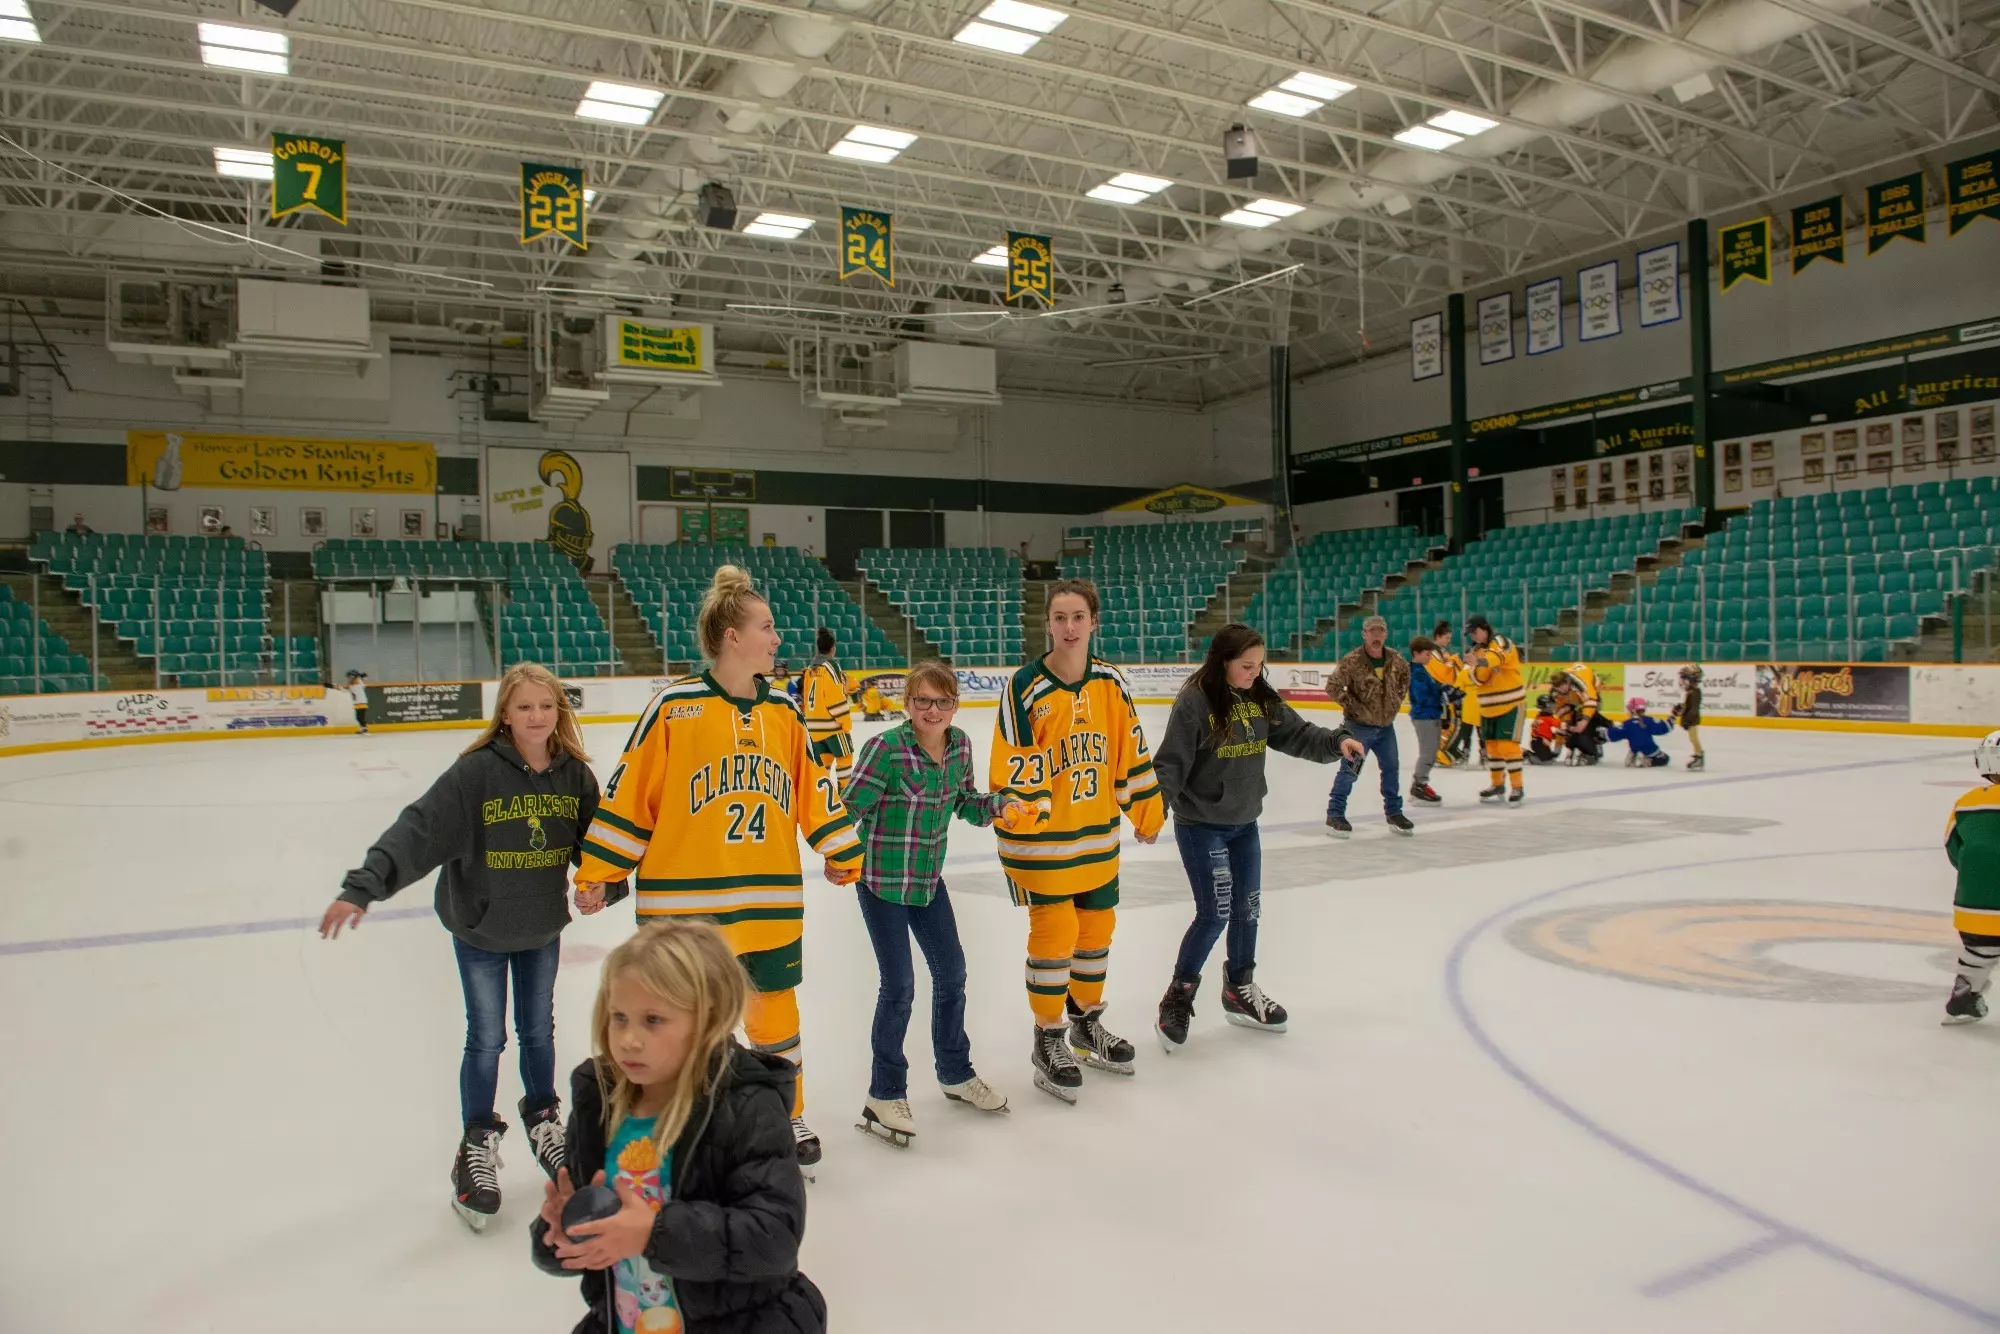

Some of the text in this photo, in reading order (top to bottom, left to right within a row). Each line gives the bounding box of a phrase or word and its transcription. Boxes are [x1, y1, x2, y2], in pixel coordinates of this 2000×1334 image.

[275, 139, 342, 164] CONROY
[296, 161, 323, 200] 7
[1959, 177, 1998, 197] NCAA
[529, 195, 578, 231] 22
[846, 212, 888, 235] TAYLOR
[1878, 200, 1916, 219] NCAA
[1801, 222, 1834, 240] NCAA
[847, 233, 886, 269] 24
[1013, 258, 1047, 289] 25
[1855, 390, 1888, 414] All
[253, 441, 297, 458] Lord
[302, 442, 386, 464] Stanley's
[219, 459, 415, 488] Golden Knights
[206, 686, 327, 702] BARSTOW
[808, 677, 817, 711] 4
[1643, 671, 1675, 688] Eben
[116, 693, 169, 711] CHIP'S
[605, 762, 629, 801] 4
[690, 752, 793, 816] CLARKSON
[1007, 753, 1045, 788] 23
[1070, 766, 1099, 805] 23
[482, 794, 581, 826] CLARKSON
[816, 775, 846, 816] 2
[725, 801, 767, 843] 24
